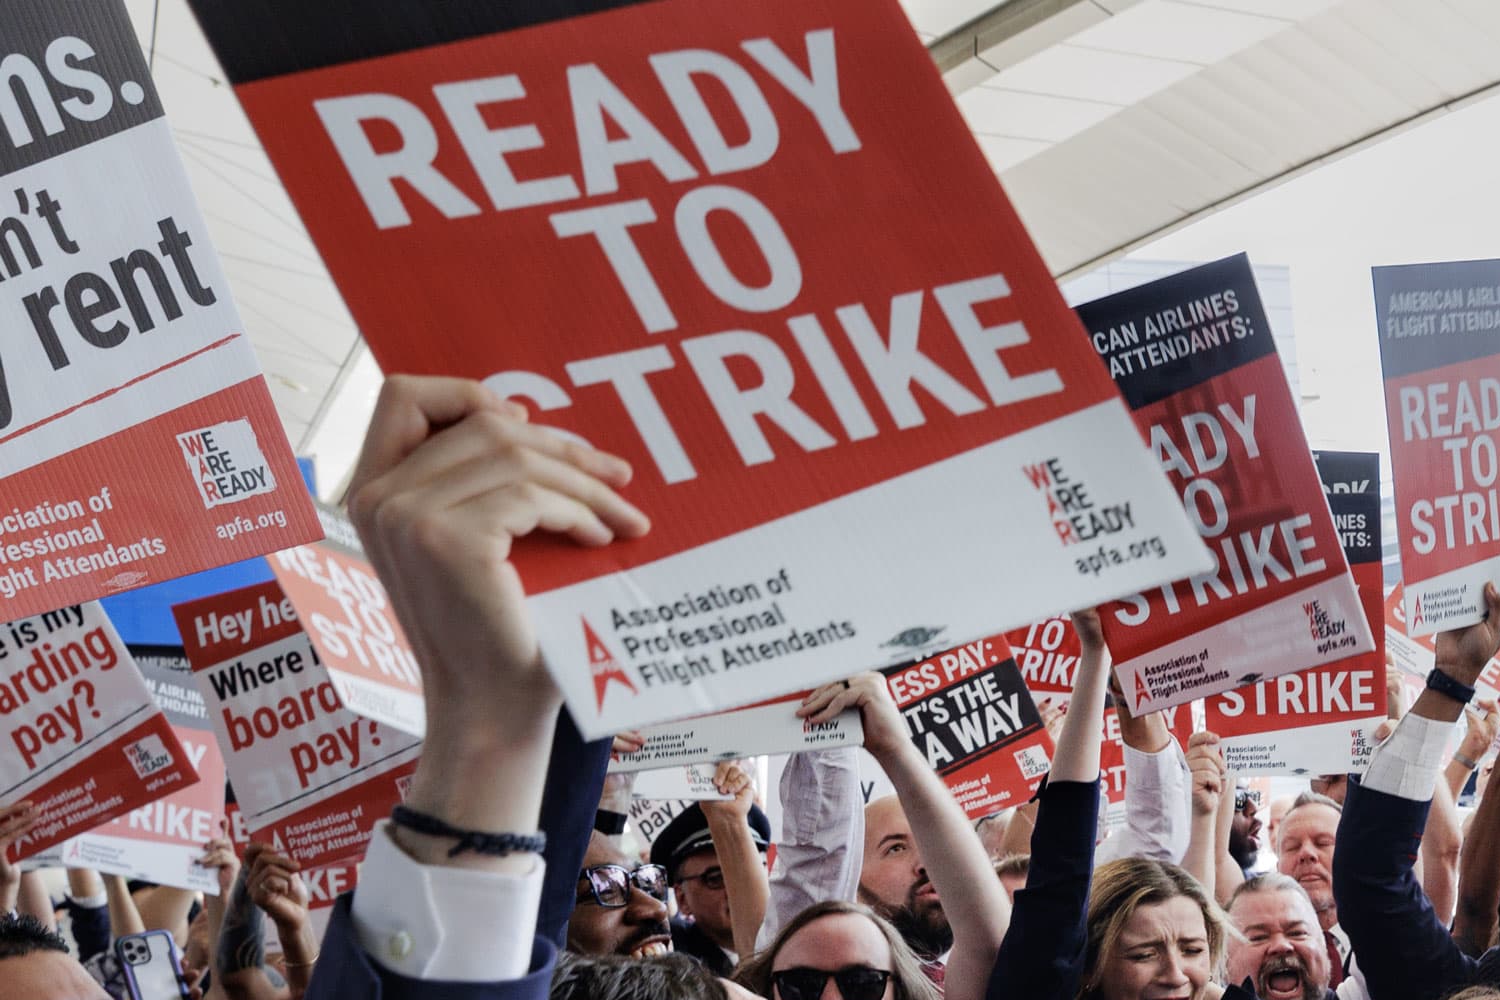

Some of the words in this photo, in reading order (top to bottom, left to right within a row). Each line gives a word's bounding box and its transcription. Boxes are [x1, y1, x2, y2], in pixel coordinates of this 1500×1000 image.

[314, 29, 862, 229] READY
[548, 186, 802, 334] TO
[22, 217, 216, 370] rent
[1390, 288, 1463, 314] AMERICAN
[1145, 289, 1239, 340] AIRLINES
[1387, 315, 1437, 339] FLIGHT
[1109, 315, 1254, 379] ATTENDANTS:
[182, 431, 218, 457] WE
[199, 451, 236, 480] ARE
[1023, 459, 1068, 490] WE
[1444, 435, 1497, 490] TO
[89, 487, 112, 512] of
[203, 466, 267, 503] READY
[1046, 481, 1093, 516] ARE
[216, 510, 287, 540] apfa.org
[1054, 502, 1134, 547] READY
[42, 537, 166, 583] Attendants
[1076, 536, 1165, 576] apfa.org
[610, 580, 766, 631] Association
[772, 569, 792, 595] of
[1303, 600, 1320, 616] WE
[1423, 588, 1458, 600] Association
[1424, 597, 1462, 611] Professional
[8, 620, 38, 649] is
[194, 607, 253, 647] Hey
[621, 609, 785, 659] Professional
[1024, 620, 1065, 650] TO
[1312, 620, 1346, 640] READY
[637, 650, 715, 689] Flight
[721, 619, 856, 667] Attendants
[942, 640, 998, 680] PAY:
[1317, 636, 1356, 654] apfa.org
[209, 651, 303, 700] Where
[1144, 652, 1197, 677] Association
[1148, 664, 1205, 688] Professional
[947, 672, 1002, 714] THE
[1151, 684, 1177, 699] Flight
[1180, 670, 1229, 692] Attendants
[10, 679, 101, 769] pay?
[950, 693, 1023, 753] WAY
[1227, 745, 1267, 753] Association
[1227, 753, 1270, 761] Professional
[1249, 761, 1286, 769] Attendants
[628, 797, 651, 819] We
[637, 803, 673, 842] pay
[286, 811, 348, 836] Association
[288, 821, 357, 845] Professional
